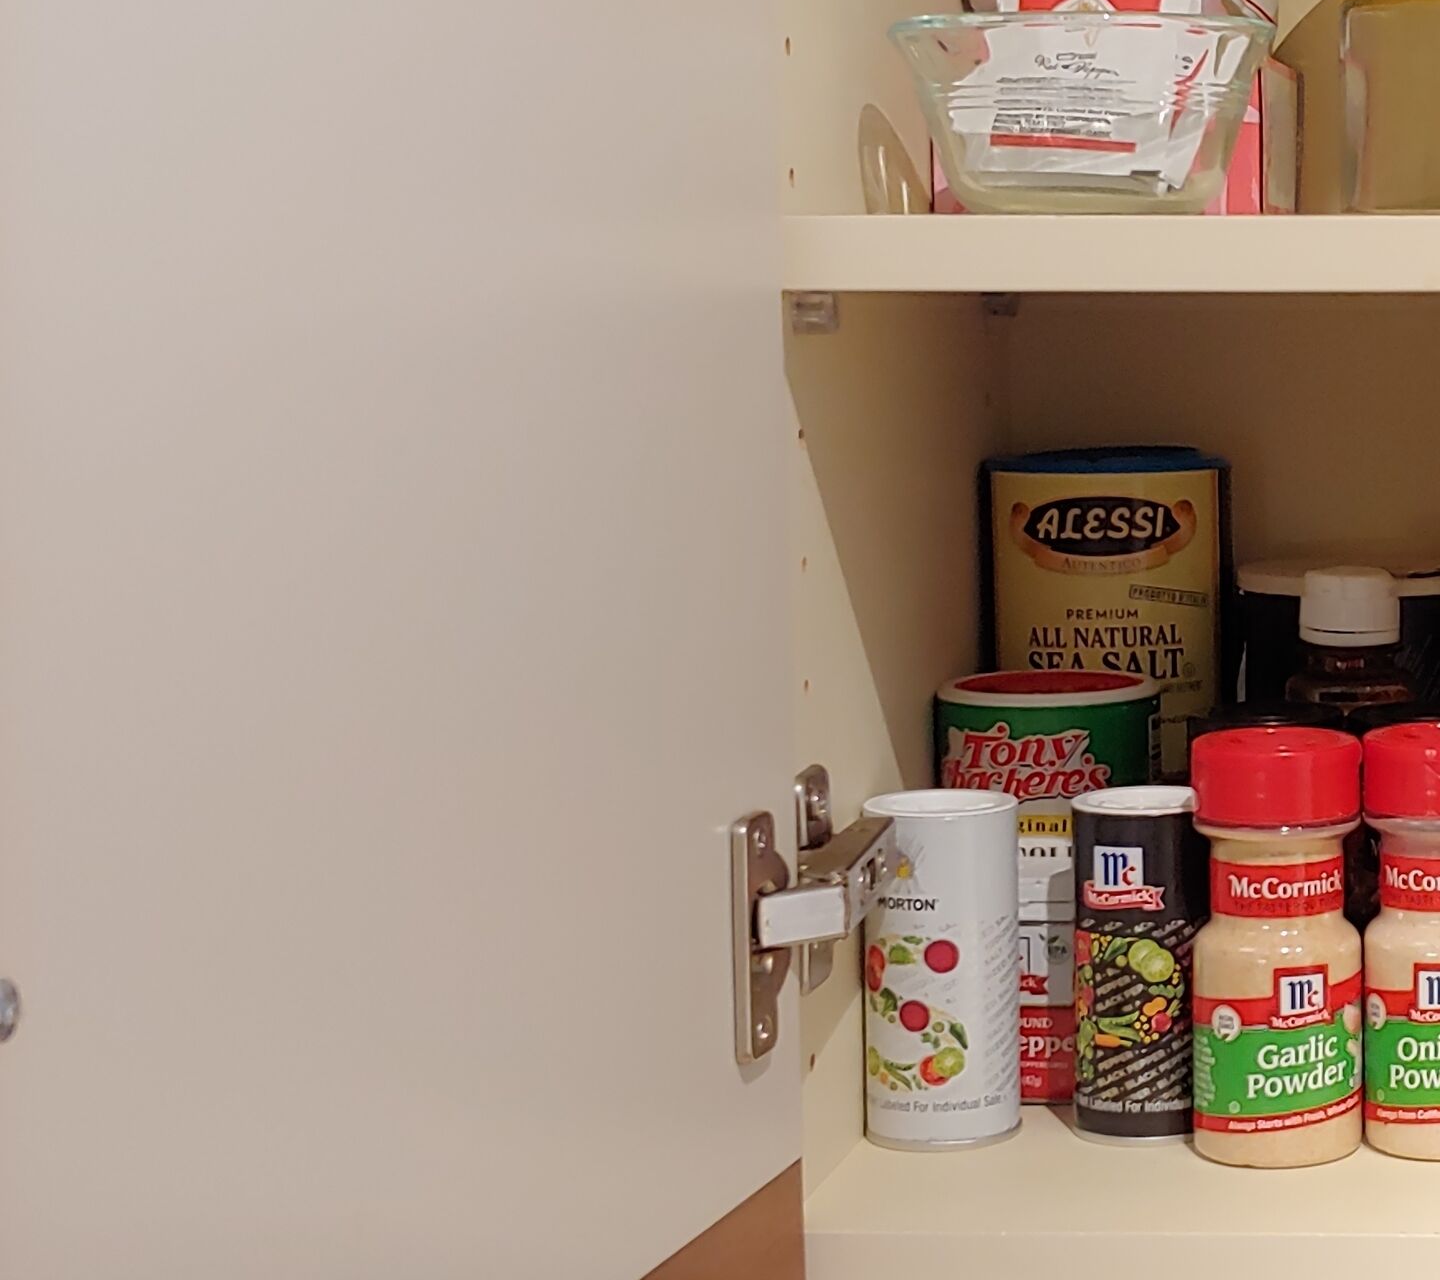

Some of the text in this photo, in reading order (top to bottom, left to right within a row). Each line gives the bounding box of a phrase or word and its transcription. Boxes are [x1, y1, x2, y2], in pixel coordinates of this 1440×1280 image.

[1036, 506, 1166, 540] ALESSI
[1066, 608, 1139, 620] PREMIUM
[1028, 623, 1182, 649] ALL NATURAL
[1028, 648, 1184, 679] SEA SALT
[963, 724, 1090, 770] Tony
[1018, 818, 1068, 834] ginal
[1227, 869, 1343, 900] McCormick
[877, 897, 937, 911] MORTON
[1257, 1033, 1339, 1070] Garlic
[1246, 1060, 1347, 1099] Powder
[913, 1101, 929, 1113] For
[1125, 1100, 1143, 1113] For
